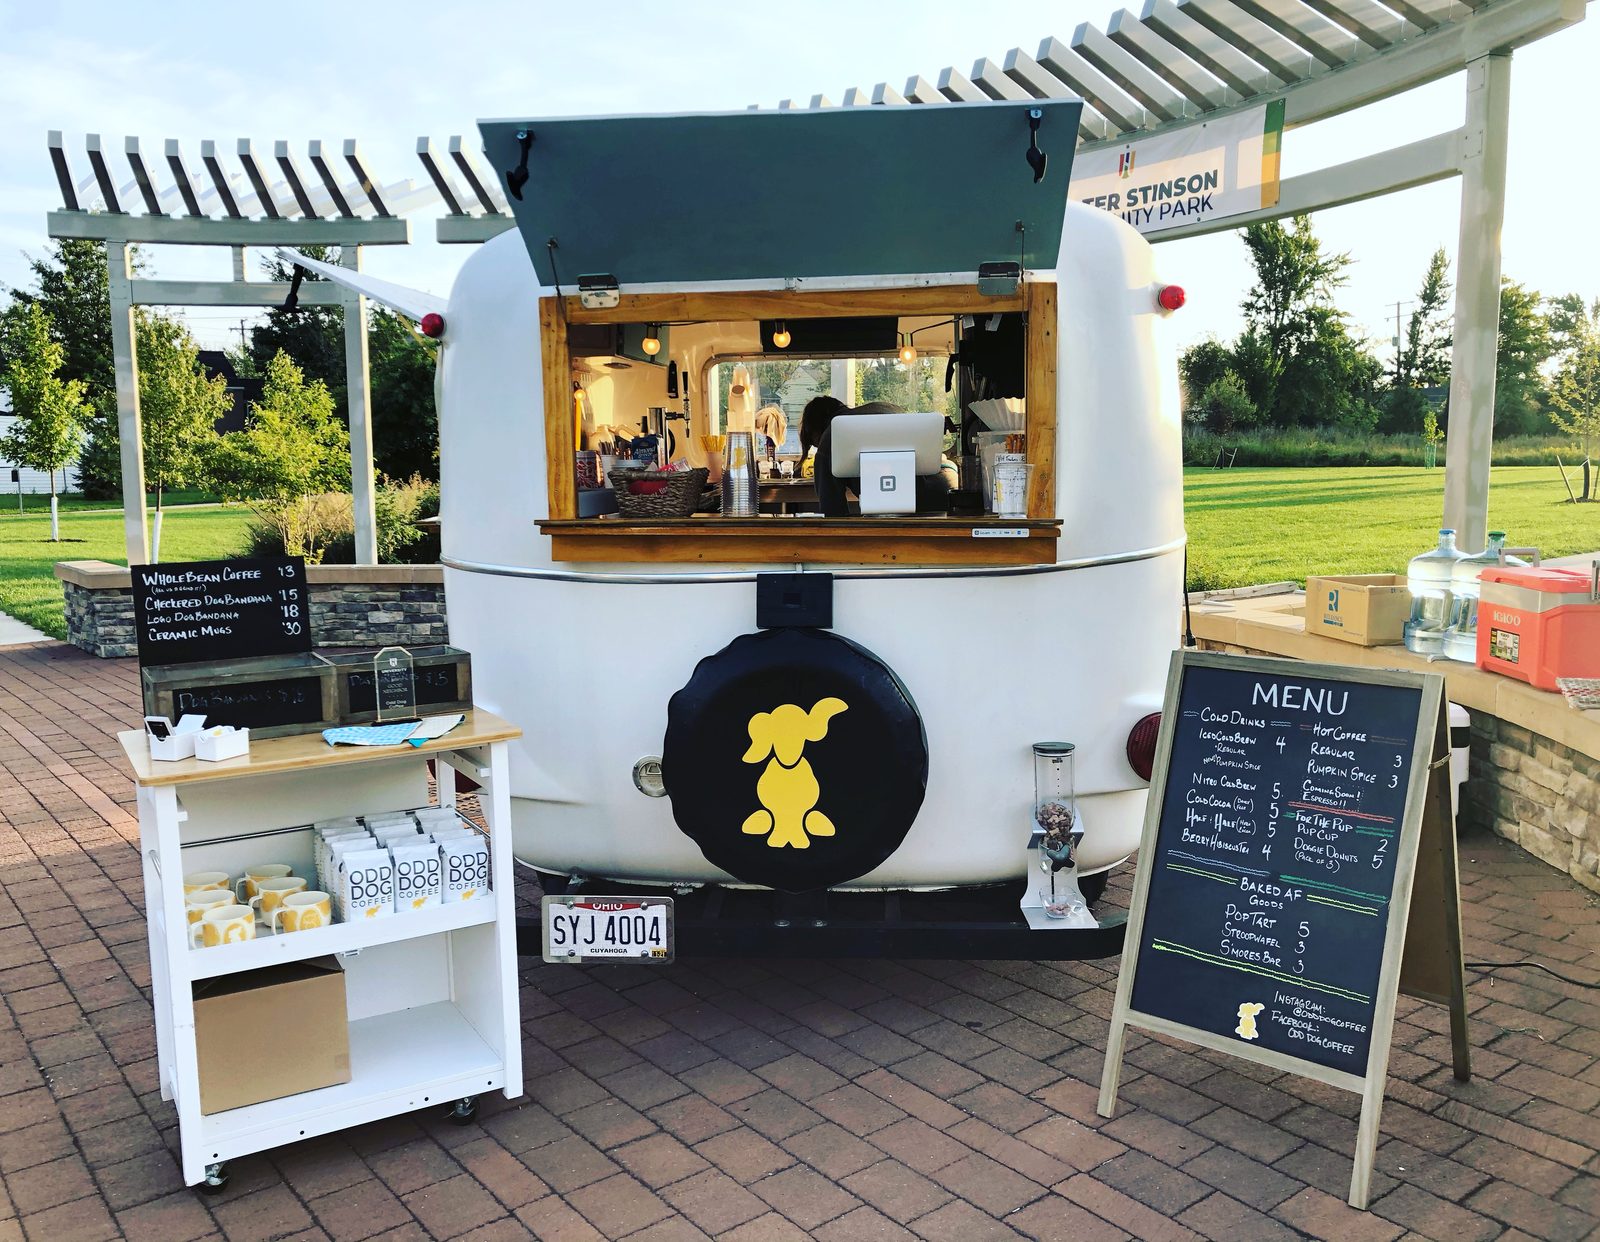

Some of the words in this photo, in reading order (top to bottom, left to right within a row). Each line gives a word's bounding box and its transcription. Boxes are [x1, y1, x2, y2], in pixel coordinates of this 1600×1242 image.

[1127, 169, 1218, 207] STINSON
[1160, 192, 1213, 220] PARK
[142, 572, 185, 586] WHOLE
[185, 571, 220, 583] BEAN
[223, 567, 261, 581] COFFEE
[145, 597, 201, 611] CHECKERED
[147, 614, 172, 624] LOGO
[148, 628, 198, 642] CERAMIC
[201, 625, 232, 637] MUGS
[1252, 682, 1349, 716] MENU
[1200, 706, 1229, 722] COLD
[1230, 710, 1265, 728] DRINKS
[1199, 727, 1216, 739] ICED
[1215, 730, 1234, 742] COLD
[1234, 732, 1256, 745] BREW
[1275, 736, 1286, 754] 4
[1313, 722, 1334, 736] HOT
[1333, 726, 1367, 742] COFFEE
[1216, 756, 1243, 769] PUMPKIN
[1244, 761, 1261, 771] SPICE
[1310, 742, 1356, 760] REGULAR
[1393, 755, 1402, 768] 3
[1192, 772, 1218, 787] NITRO
[1307, 759, 1347, 778] PUMPKIN
[1350, 767, 1377, 783] SPICE
[1387, 774, 1398, 789] 3
[1303, 779, 1334, 795] COMING
[1186, 788, 1208, 804] COLD
[1209, 795, 1232, 809] COCOA
[1269, 803, 1279, 819] 5
[1186, 807, 1208, 827] HALF
[1214, 813, 1237, 832] HALF
[1268, 821, 1277, 838] 5
[1295, 809, 1312, 825] FOR
[1312, 813, 1331, 829] THE
[1332, 817, 1353, 833] PUP
[1181, 828, 1209, 847] BERRY
[1262, 844, 1272, 861] 4
[1297, 823, 1317, 836] PUP
[1317, 830, 1339, 841] CUP
[1377, 839, 1388, 853] 2
[449, 852, 488, 868] ODD
[1294, 837, 1324, 855] DOGGIE
[1326, 845, 1359, 863] DONUTS
[1371, 855, 1384, 869] 5
[350, 866, 392, 885] ODD
[398, 858, 440, 876] ODD
[450, 866, 487, 882] DOG
[1325, 860, 1340, 874] 3)
[351, 880, 392, 900] DOG
[398, 872, 439, 890] DOG
[449, 879, 487, 890] COFFEE
[1240, 877, 1281, 896] BAKED
[1284, 888, 1303, 901] AF
[351, 895, 392, 908] COFFEE
[399, 887, 439, 899] COFFEE
[1249, 895, 1284, 910] GOODS
[592, 903, 623, 911] OHIO
[553, 915, 595, 945] SYJ
[604, 916, 661, 945] 4004
[1225, 903, 1250, 922] POP
[1249, 912, 1277, 929] TART
[1298, 921, 1310, 937] 5
[1221, 921, 1281, 948] STROOPWAFEL
[1294, 941, 1306, 954] 3
[1220, 939, 1261, 961] S'MORES
[1262, 951, 1281, 968] BAR
[1292, 959, 1304, 974] 3
[1274, 990, 1326, 1014] INSTAGRAM:
[1271, 1010, 1320, 1032] FACEBOOK:
[1288, 1027, 1305, 1040] ODD
[1306, 1033, 1322, 1046] DOG
[1322, 1038, 1355, 1055] COFFEE
